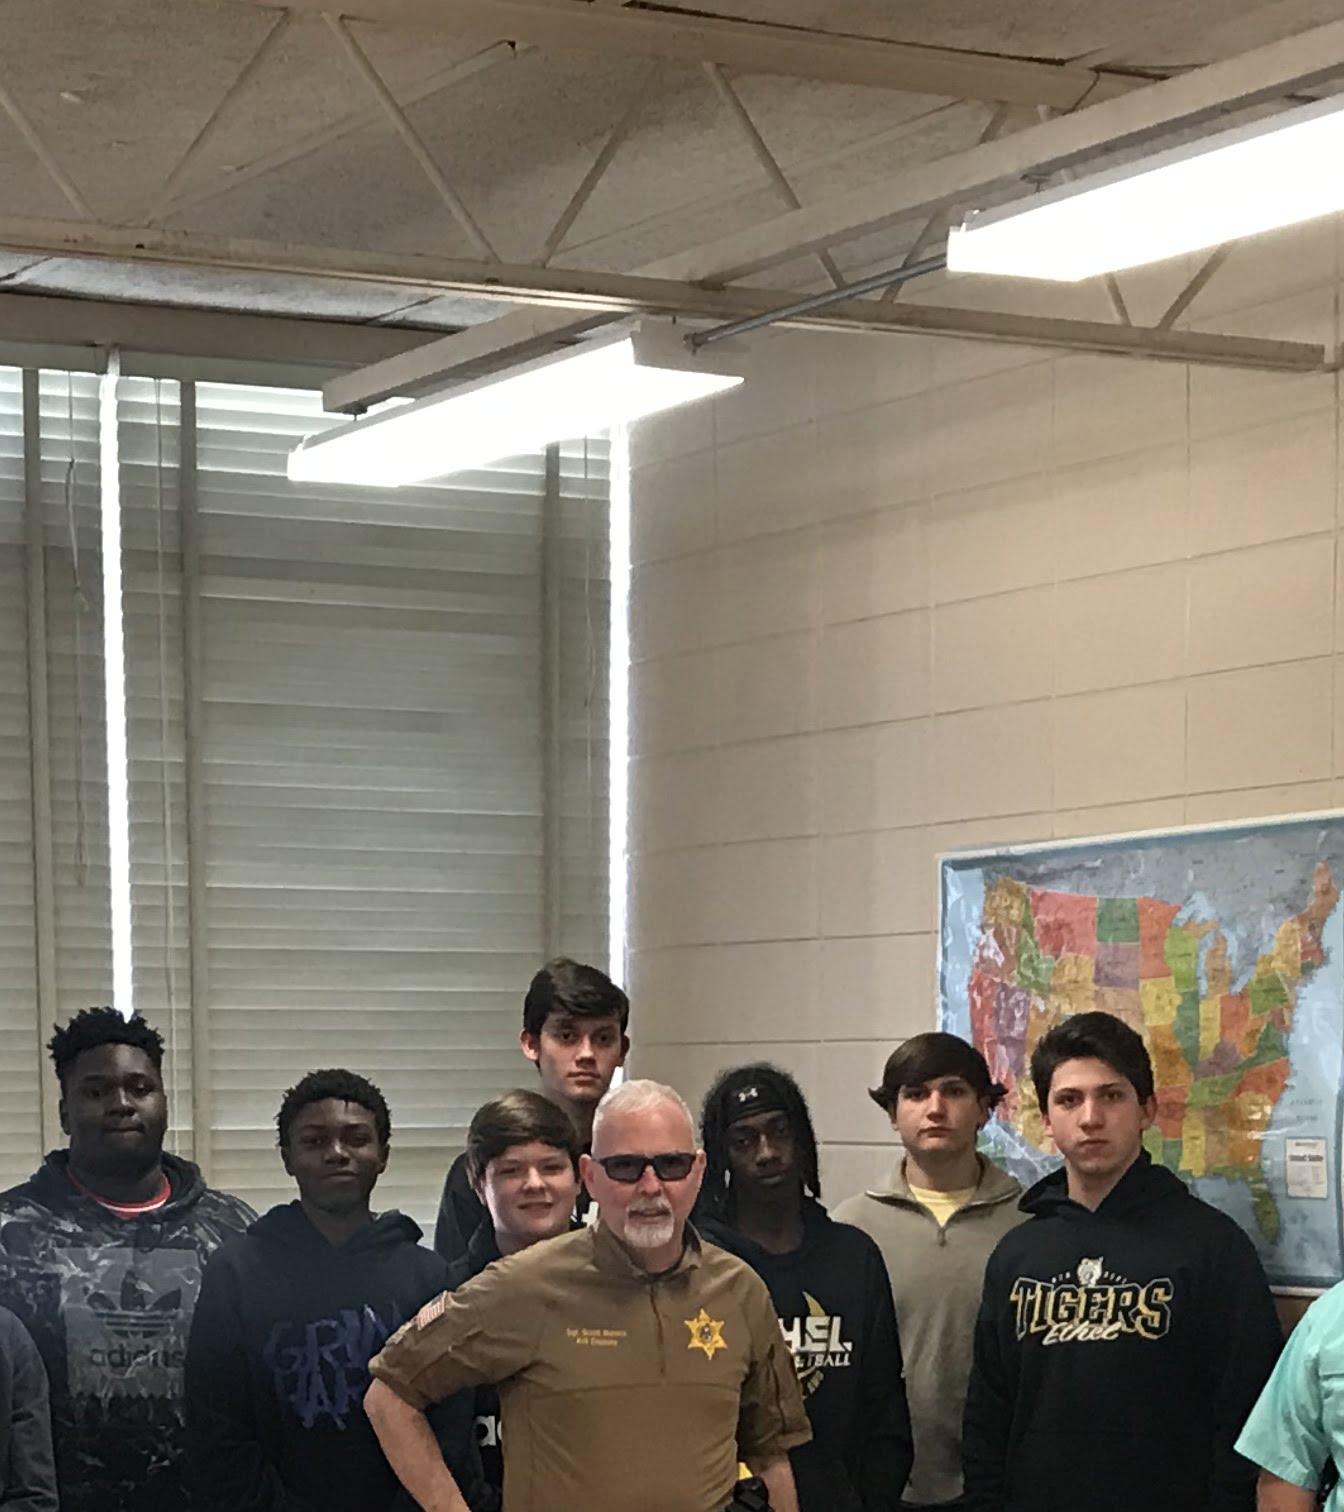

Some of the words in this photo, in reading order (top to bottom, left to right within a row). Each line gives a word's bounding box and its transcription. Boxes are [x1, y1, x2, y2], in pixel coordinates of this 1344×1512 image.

[1010, 1276, 1174, 1342] TIGERS
[777, 1314, 853, 1354] HEL
[1042, 1320, 1123, 1346] Ethel
[794, 1353, 851, 1368] ETBALL
